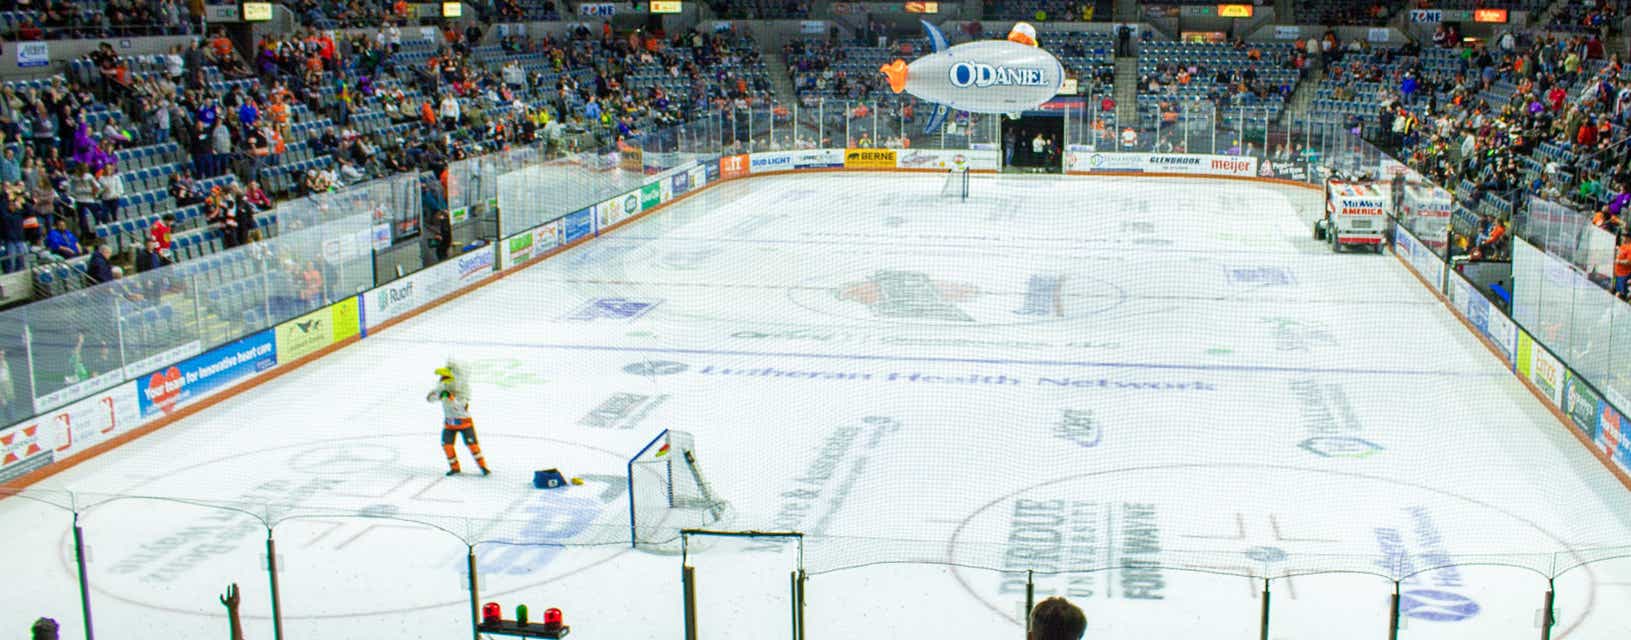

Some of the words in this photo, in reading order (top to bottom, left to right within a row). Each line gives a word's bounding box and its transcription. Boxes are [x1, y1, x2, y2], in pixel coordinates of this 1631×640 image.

[768, 156, 791, 165] LIGHT
[861, 151, 894, 161] BERNE
[1211, 157, 1250, 173] meijer
[1342, 207, 1383, 215] AMERICA
[389, 281, 413, 302] Ruoff
[144, 384, 165, 401] Your
[186, 371, 199, 384] for
[887, 371, 1021, 386] Health
[1038, 376, 1218, 392] Network
